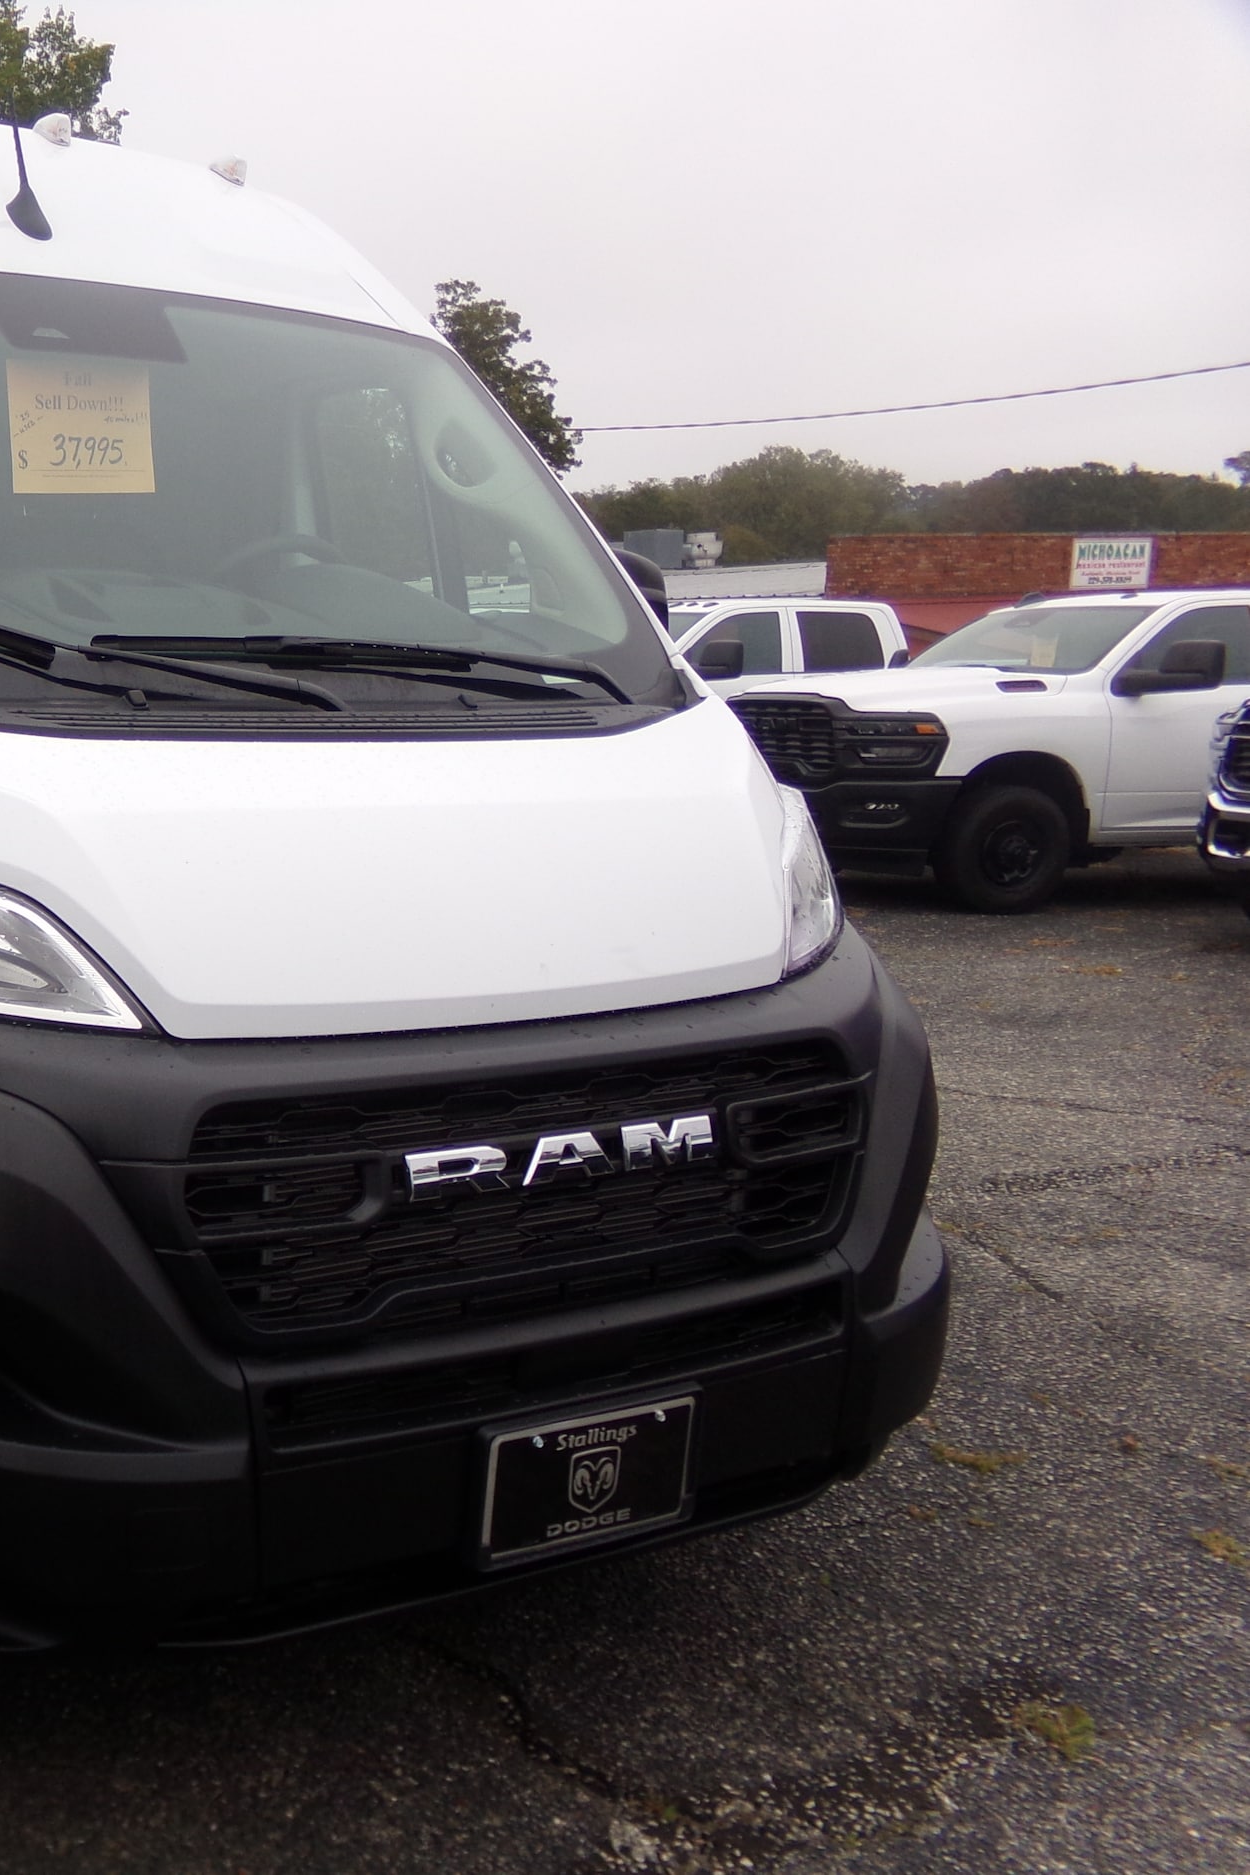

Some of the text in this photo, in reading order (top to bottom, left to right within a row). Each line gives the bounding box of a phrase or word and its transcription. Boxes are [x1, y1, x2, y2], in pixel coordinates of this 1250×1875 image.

[63, 372, 92, 387] Fall
[35, 394, 124, 412] Sell Down!!!
[18, 450, 28, 469] $
[1077, 543, 1146, 560] MICHOACAN
[405, 1115, 714, 1202] RAM
[556, 1425, 637, 1451] Stallings
[546, 1508, 631, 1537] DODGE
